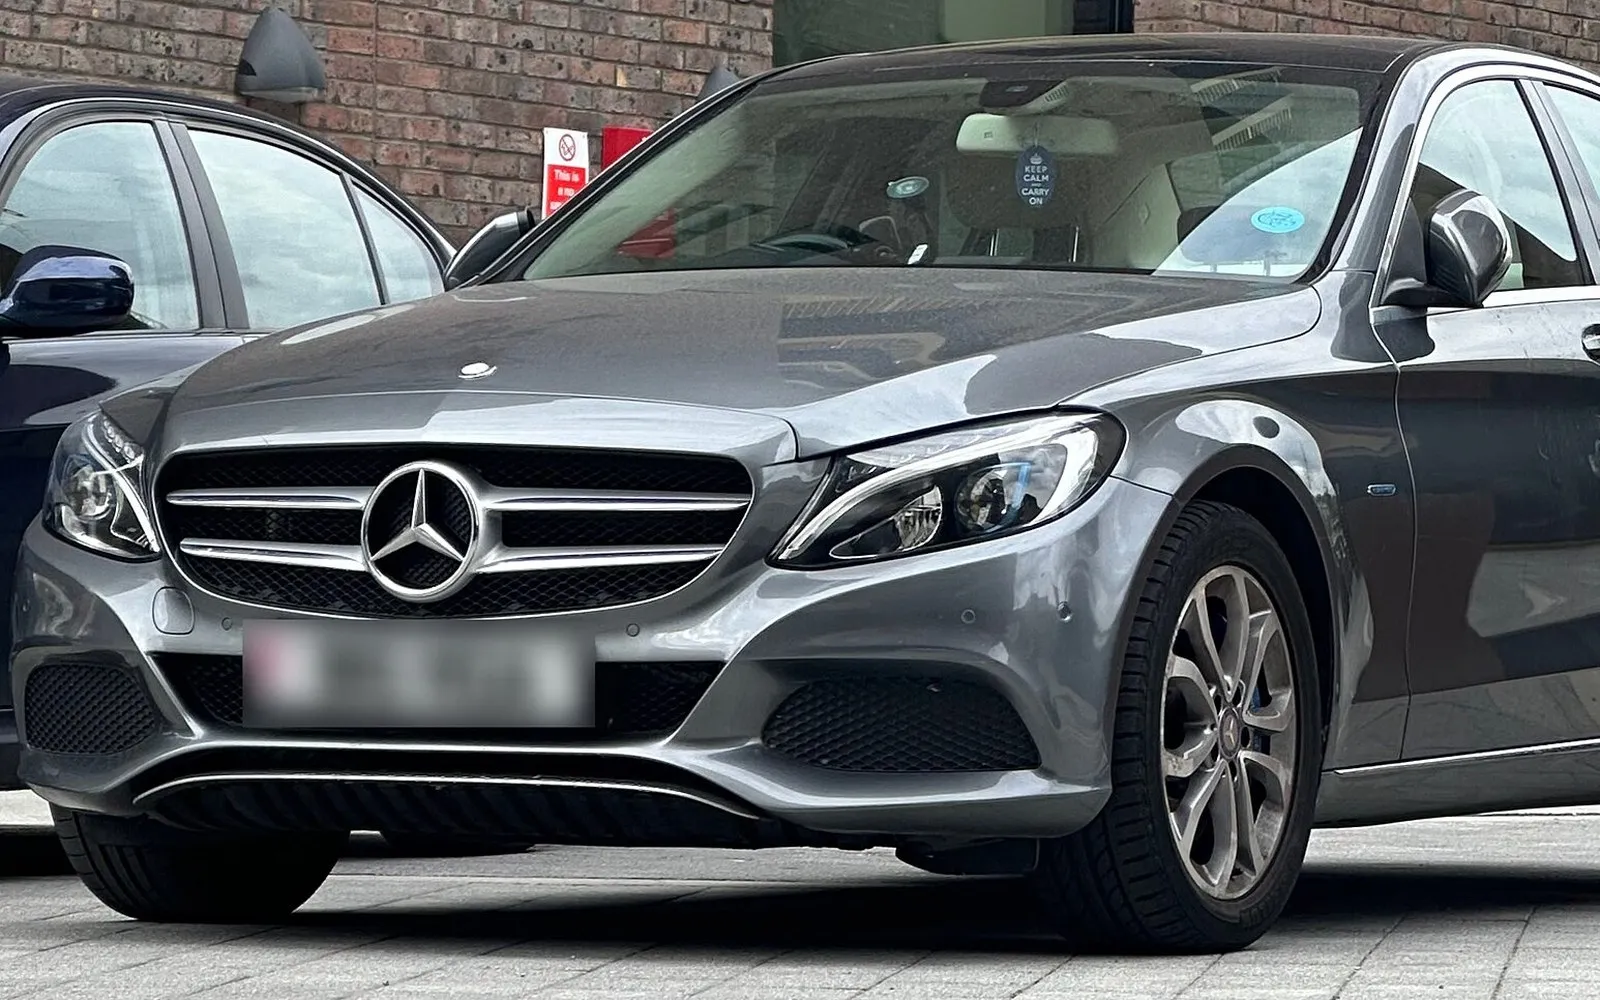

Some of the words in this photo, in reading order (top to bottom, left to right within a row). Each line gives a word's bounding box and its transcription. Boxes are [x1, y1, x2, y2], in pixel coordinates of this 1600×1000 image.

[1025, 165, 1048, 173] KEEP
[1023, 174, 1049, 182] CALM
[1021, 187, 1050, 196] CARRY
[1029, 197, 1043, 205] ON
